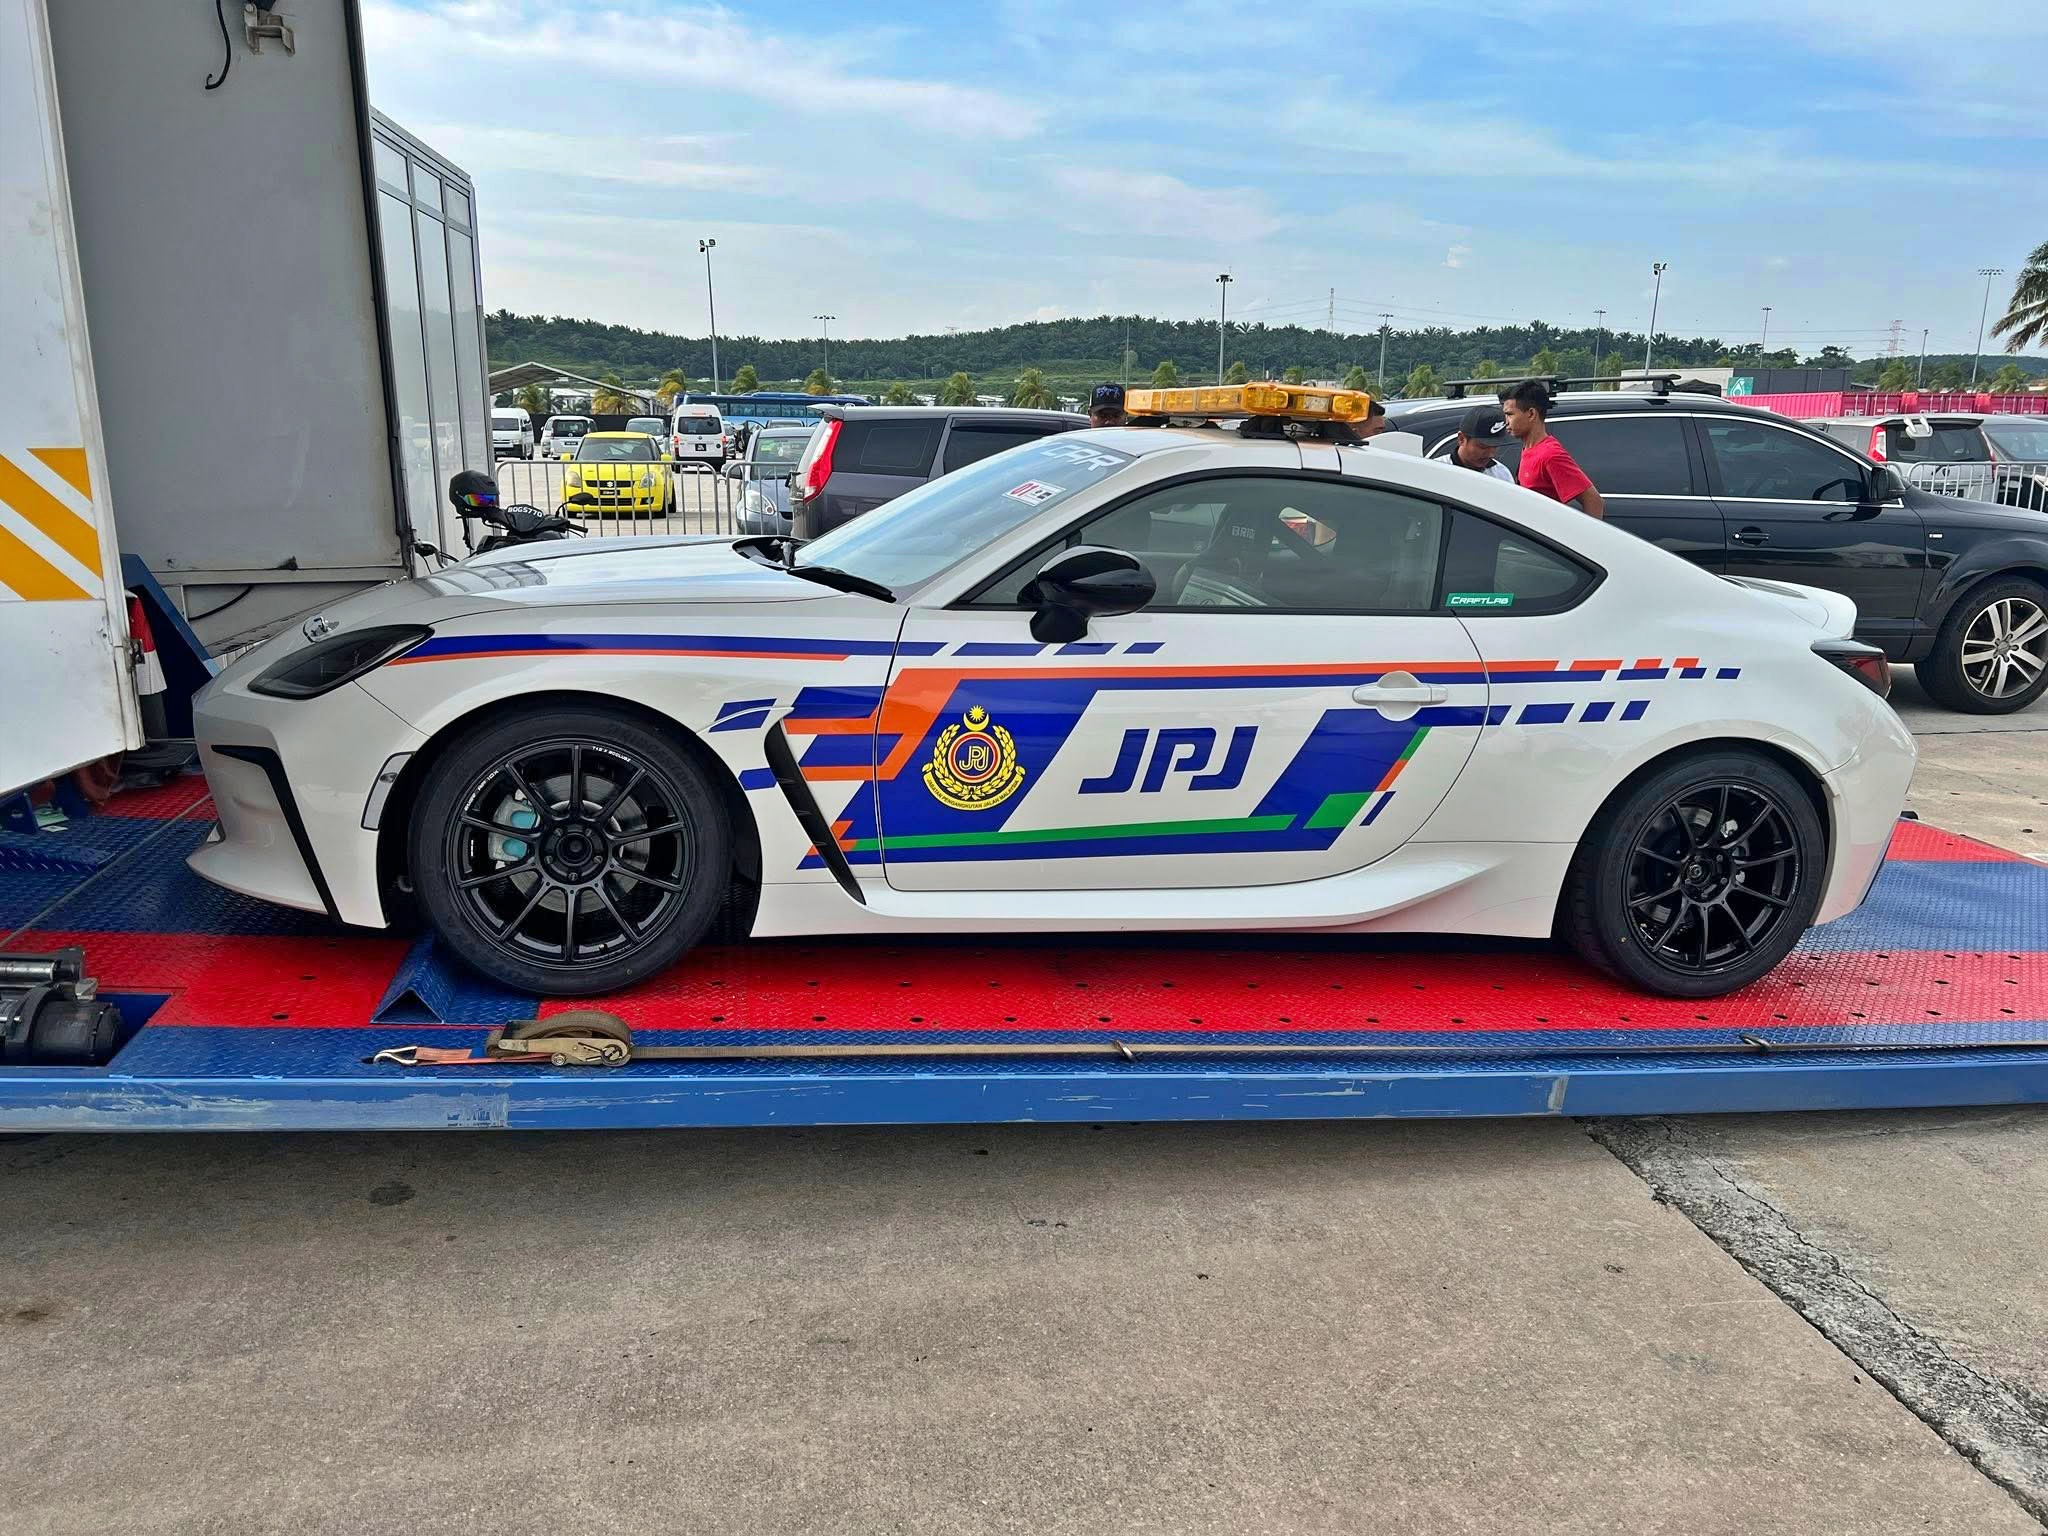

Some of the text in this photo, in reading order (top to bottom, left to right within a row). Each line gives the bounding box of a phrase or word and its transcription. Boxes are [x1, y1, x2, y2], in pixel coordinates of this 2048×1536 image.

[1040, 444, 1127, 472] CAR
[959, 745, 989, 771] JPJ
[1078, 726, 1259, 794] JPJ
[941, 795, 983, 809] PENGANGKUTAN
[983, 798, 1000, 809] JALAN
